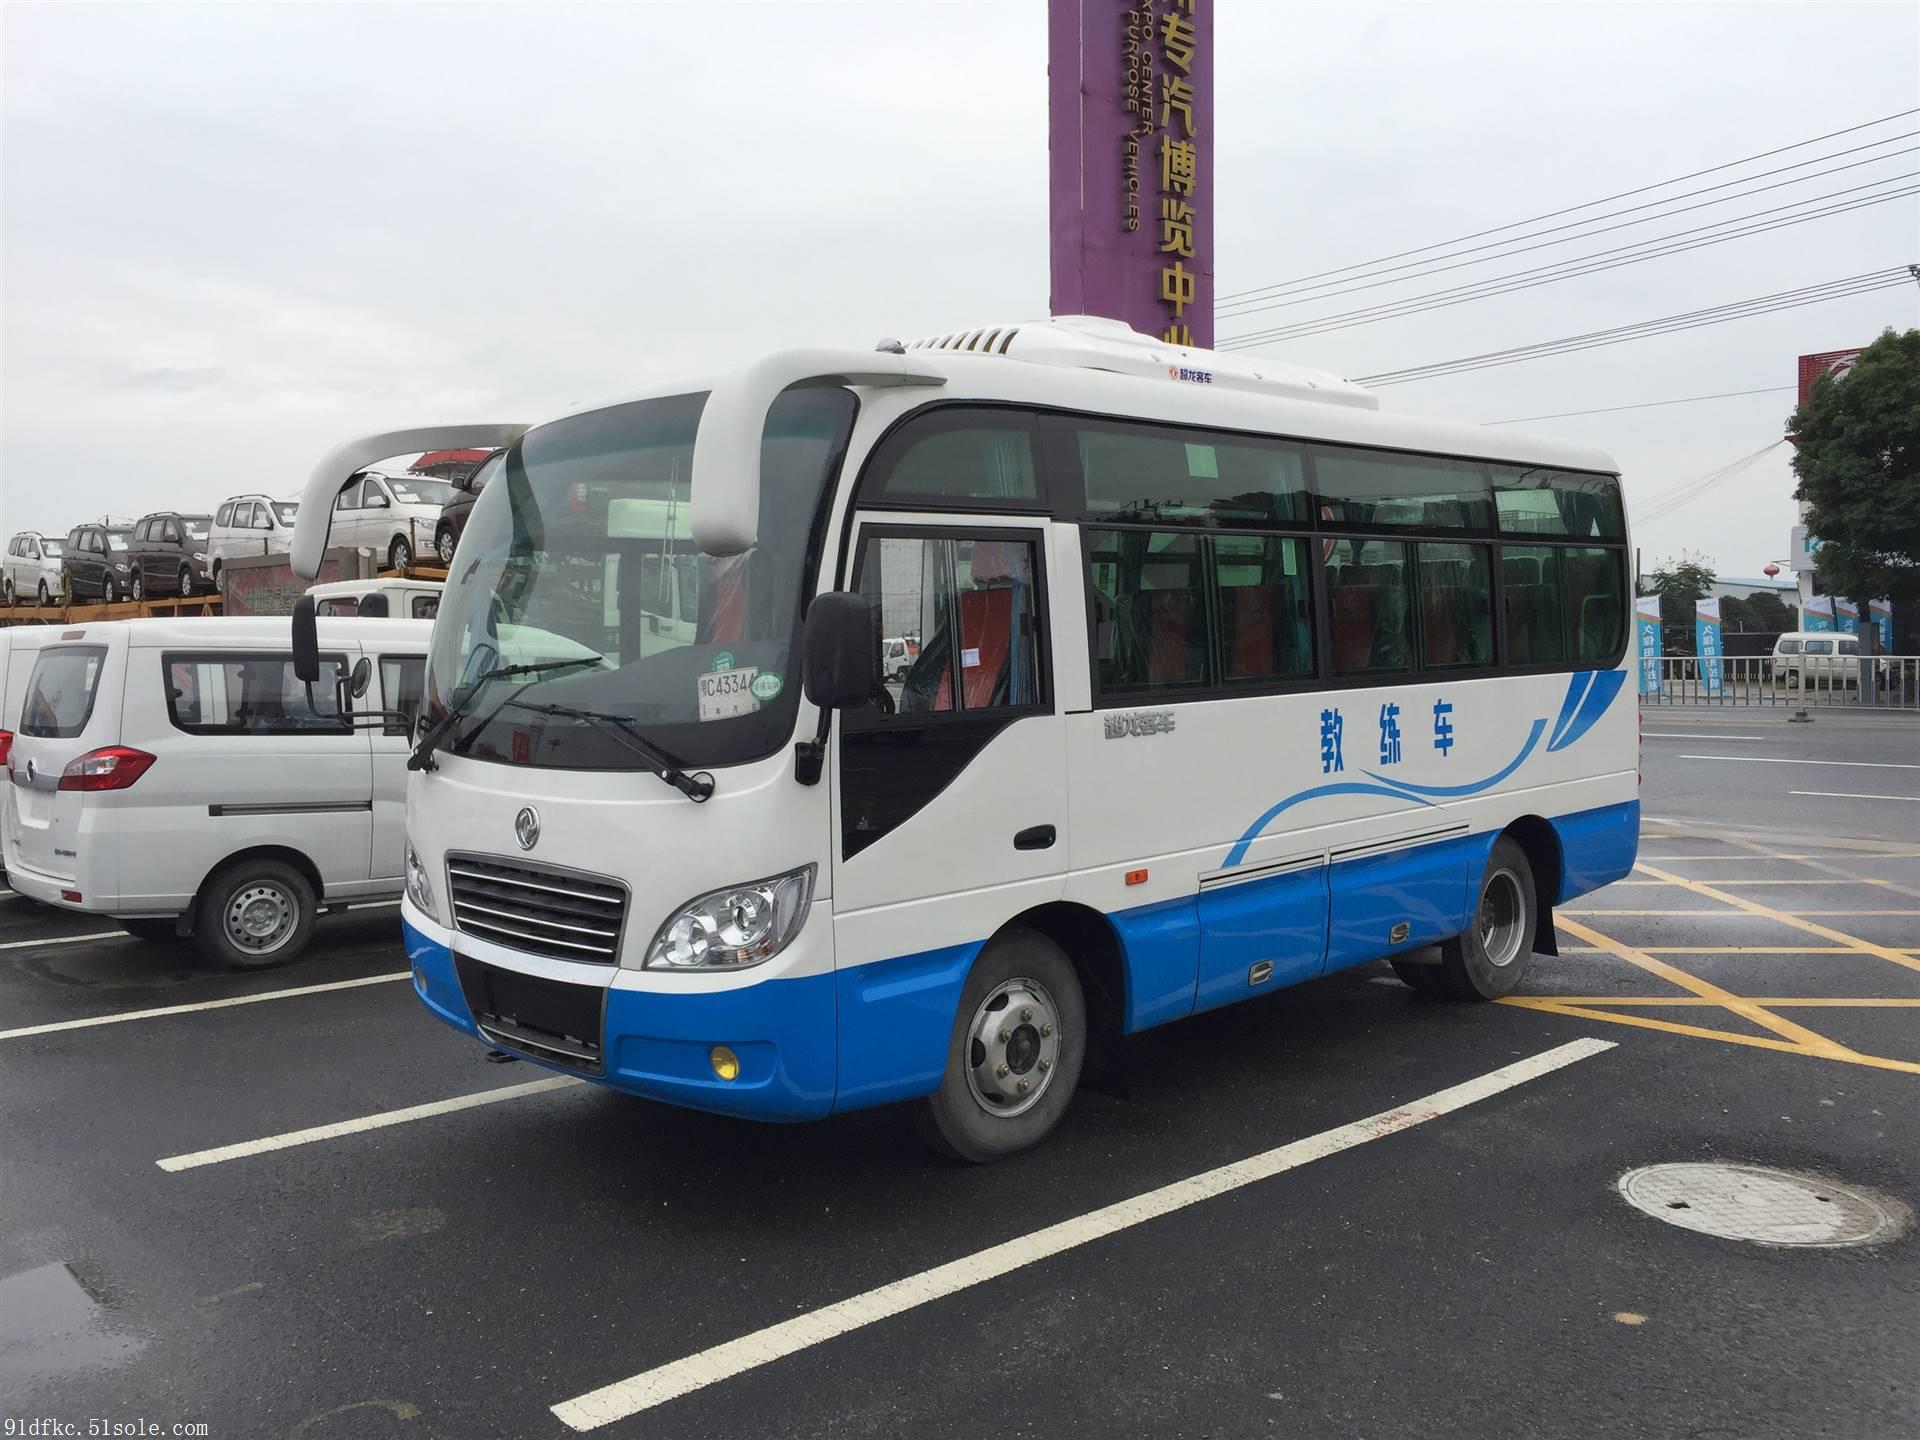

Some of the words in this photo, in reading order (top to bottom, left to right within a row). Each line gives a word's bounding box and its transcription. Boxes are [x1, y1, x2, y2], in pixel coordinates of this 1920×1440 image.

[1127, 9, 1140, 113] PURPOSE
[1142, 52, 1154, 136] CENTER
[1127, 128, 1140, 233] VEHICLES
[1161, 0, 1196, 346] 专汽博览中
[1320, 698, 1454, 773] 教练车
